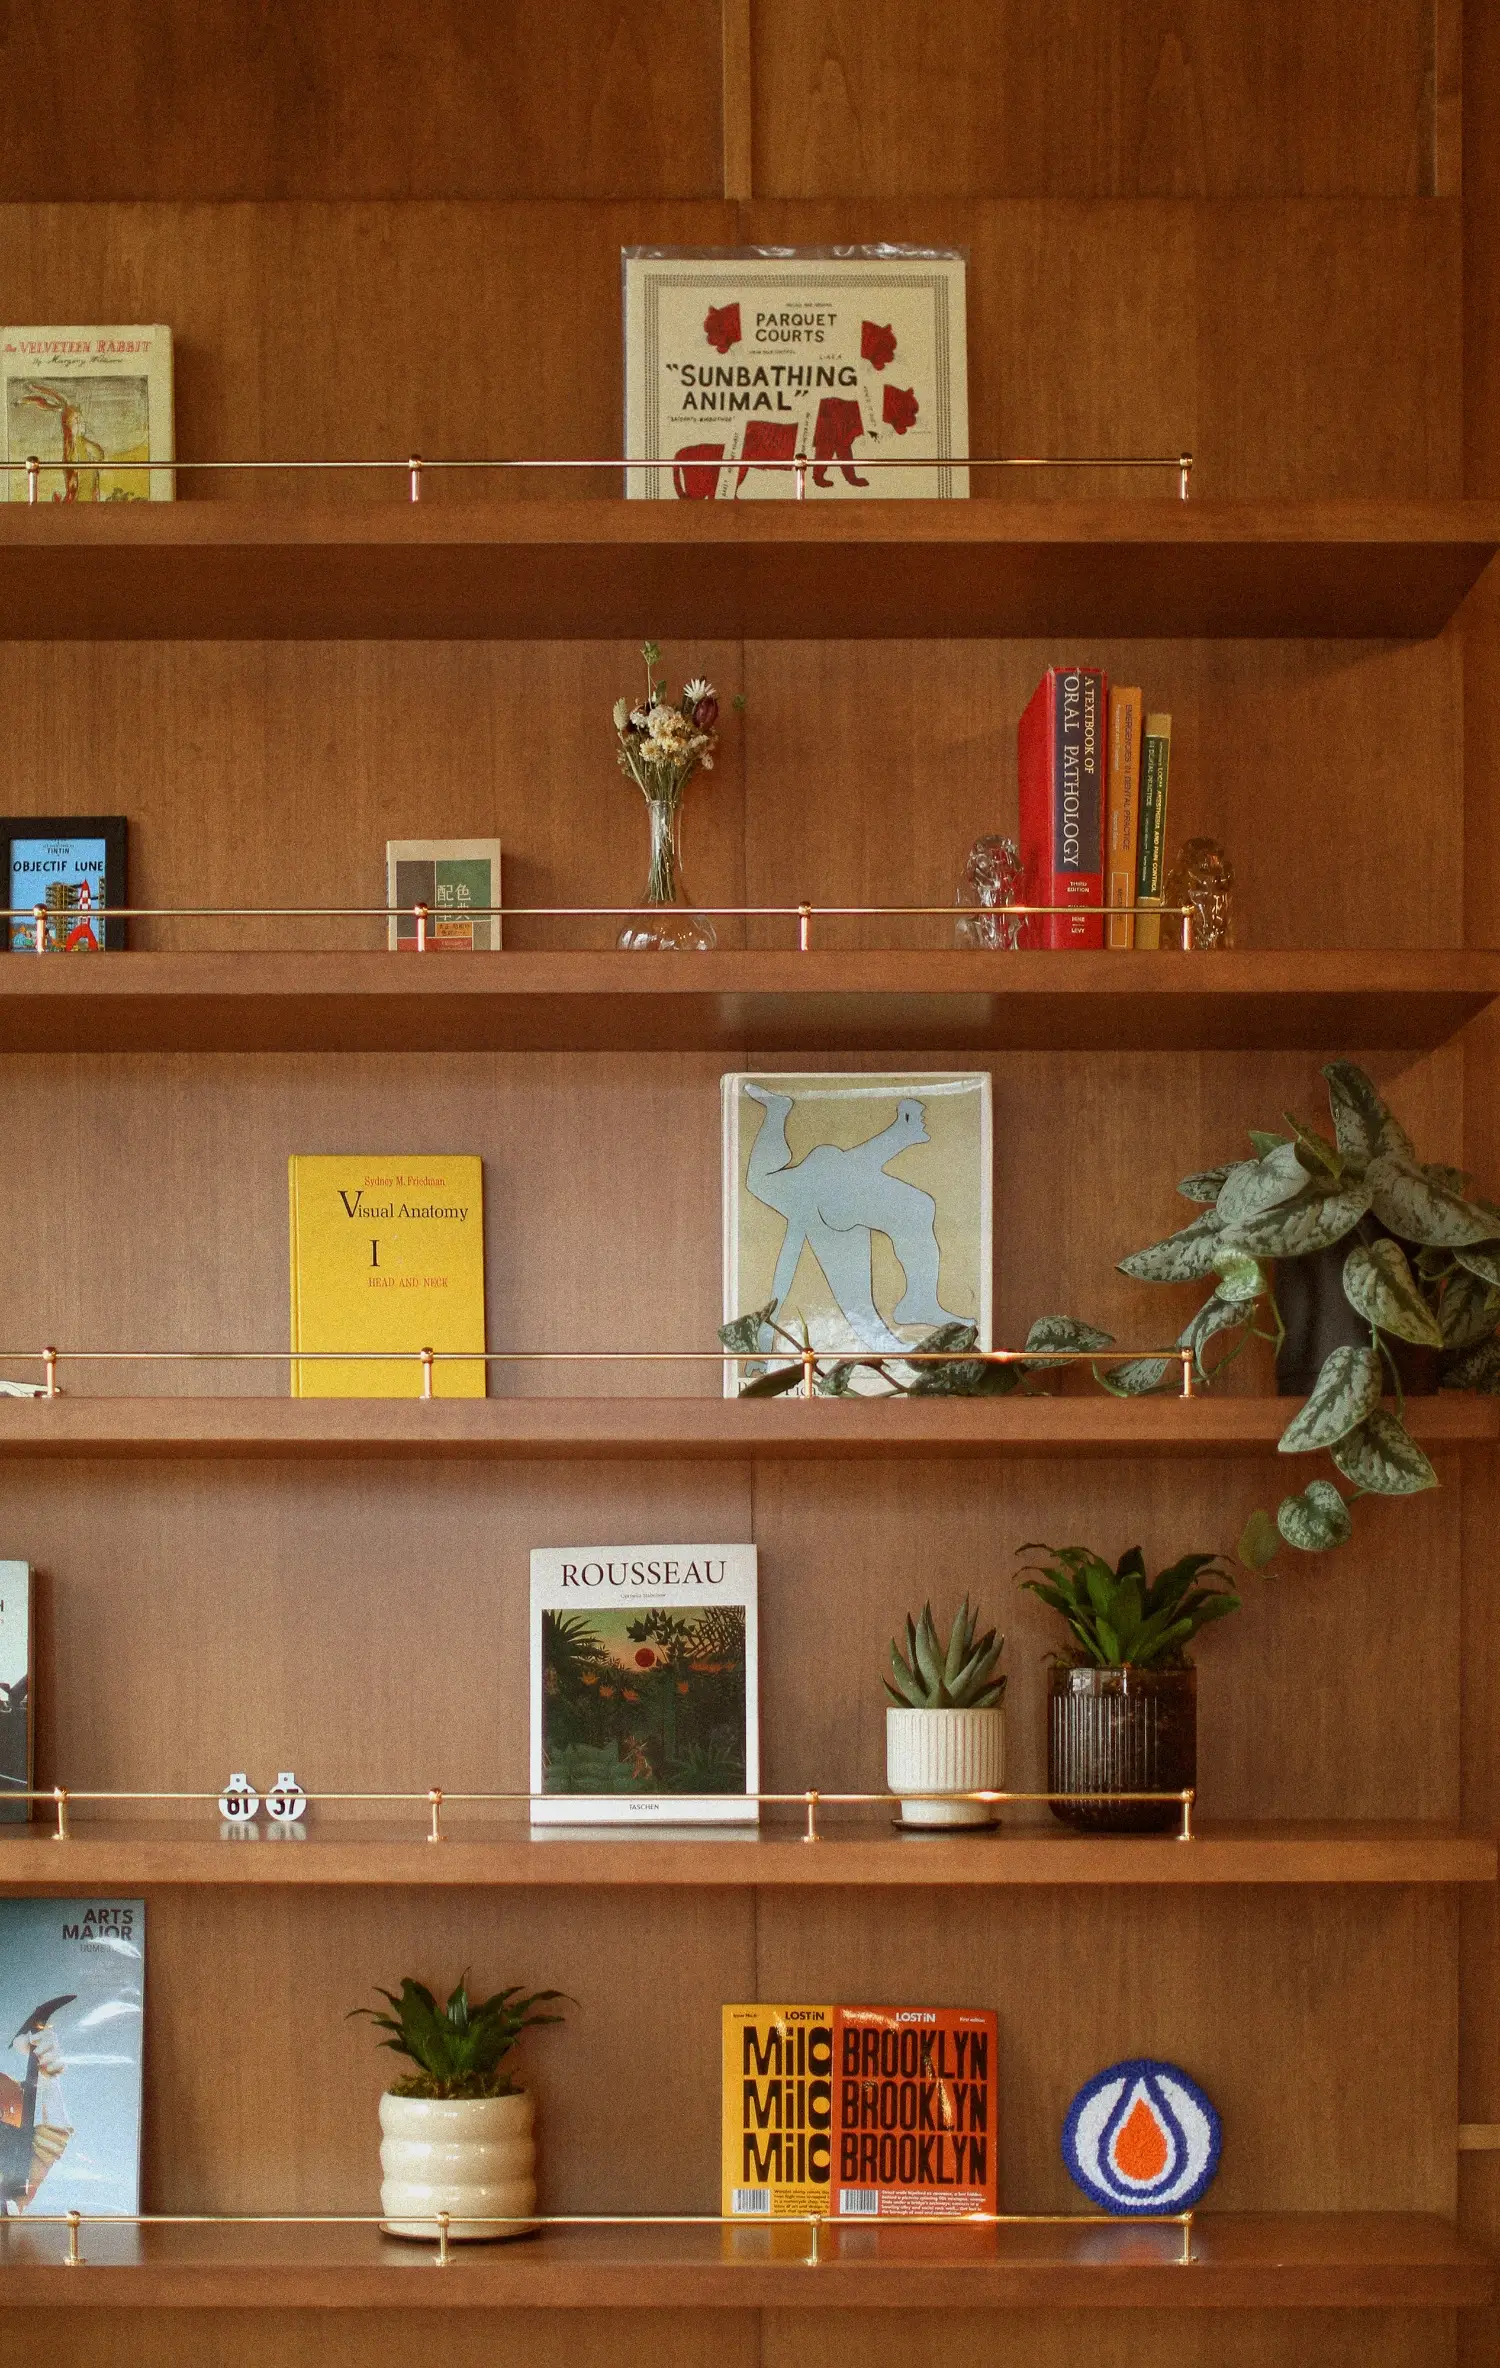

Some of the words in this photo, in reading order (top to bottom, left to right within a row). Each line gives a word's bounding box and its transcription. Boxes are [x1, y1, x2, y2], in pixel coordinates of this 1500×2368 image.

[756, 312, 837, 326] PARQUET
[20, 341, 90, 353] VELVETEEN
[96, 340, 152, 352] RABBIT
[756, 329, 824, 343] COURTS
[1084, 678, 1095, 686] A
[1063, 675, 1080, 733] ORAL
[1084, 688, 1095, 761] TEXTBOOK
[1124, 704, 1132, 763] EMERGENCIES
[1084, 762, 1095, 774] OF
[1123, 776, 1131, 807] DENTAL
[1063, 745, 1080, 867] PATHOLOGY
[1123, 810, 1131, 850] PRACTICE
[13, 860, 68, 872] OBJECTIF
[75, 860, 104, 872] LUNE
[1150, 862, 1159, 893] CONTROL
[437, 884, 471, 902] 配色
[364, 1176, 393, 1188] Sydney
[396, 1177, 405, 1186] M.
[407, 1176, 445, 1186] Friedman
[337, 1190, 395, 1218] Visual
[398, 1203, 469, 1222] Anatomy
[369, 1240, 380, 1267] I
[368, 1277, 395, 1287] HEAD
[399, 1277, 419, 1287] AND
[424, 1277, 448, 1288] NECK
[561, 1560, 727, 1587] ROUSSEAU
[83, 1908, 134, 1924] ARTS
[842, 2028, 988, 2081] BROOKLYN
[841, 2080, 987, 2133] BROOKLYN
[840, 2132, 987, 2185] BROOKLYN
